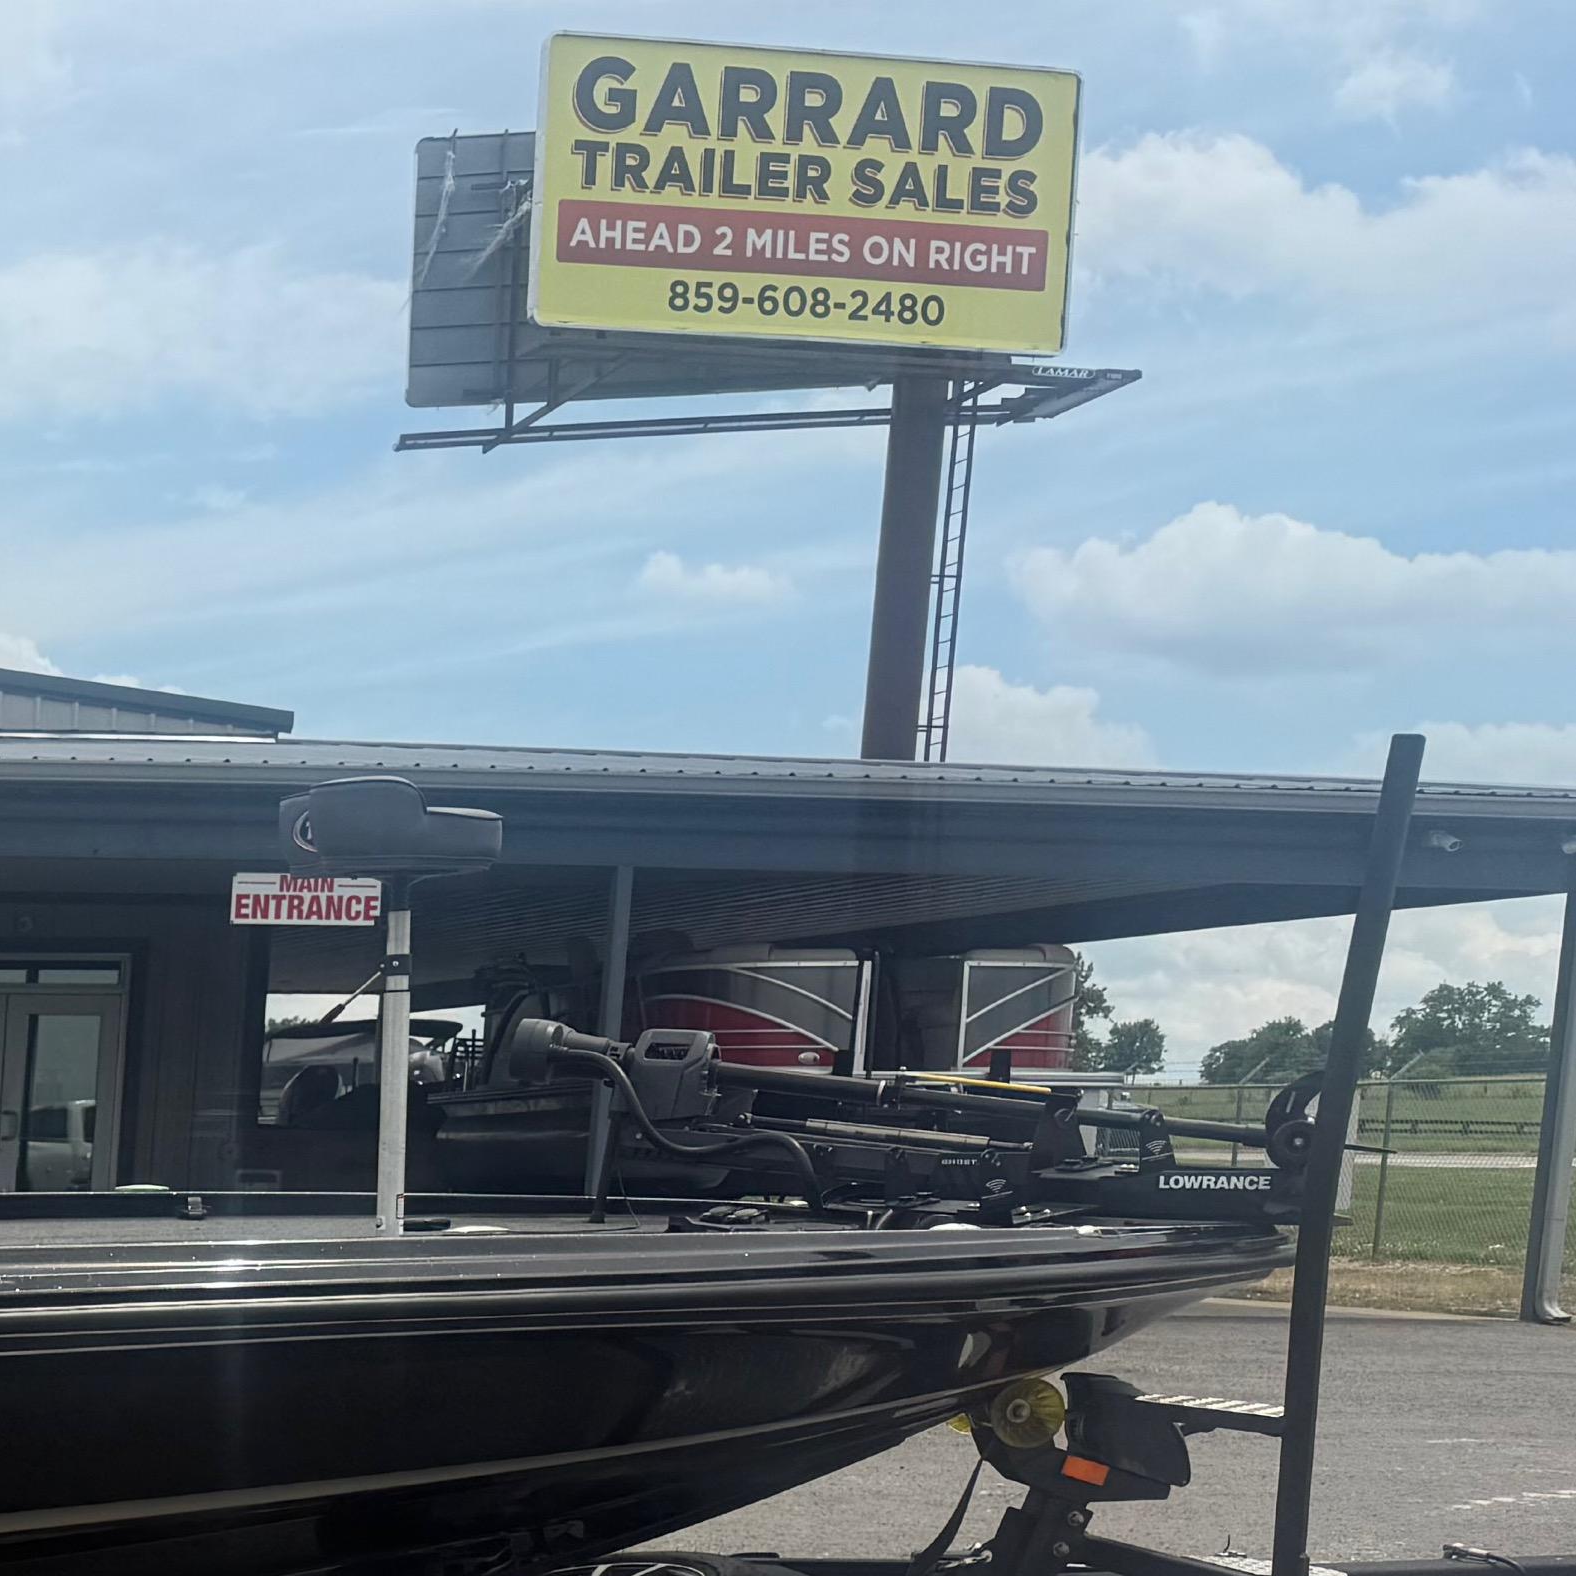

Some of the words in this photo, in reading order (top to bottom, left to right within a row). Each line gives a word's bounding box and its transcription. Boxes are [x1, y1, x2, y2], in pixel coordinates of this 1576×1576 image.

[572, 55, 1045, 161] GARRARD
[570, 138, 833, 205] TRAILER
[850, 157, 1040, 218] SALES
[569, 216, 702, 257] AHEAD
[712, 225, 735, 257] 2
[745, 228, 851, 265] MILES
[861, 236, 916, 269] ON
[929, 240, 1037, 277] RIGHT
[667, 280, 946, 327] 859-608-2480
[1036, 366, 1090, 379] LAMAR
[278, 874, 335, 893] MAIN
[233, 893, 380, 922] ENTRANCE
[1157, 1174, 1272, 1191] LOWRANCE
